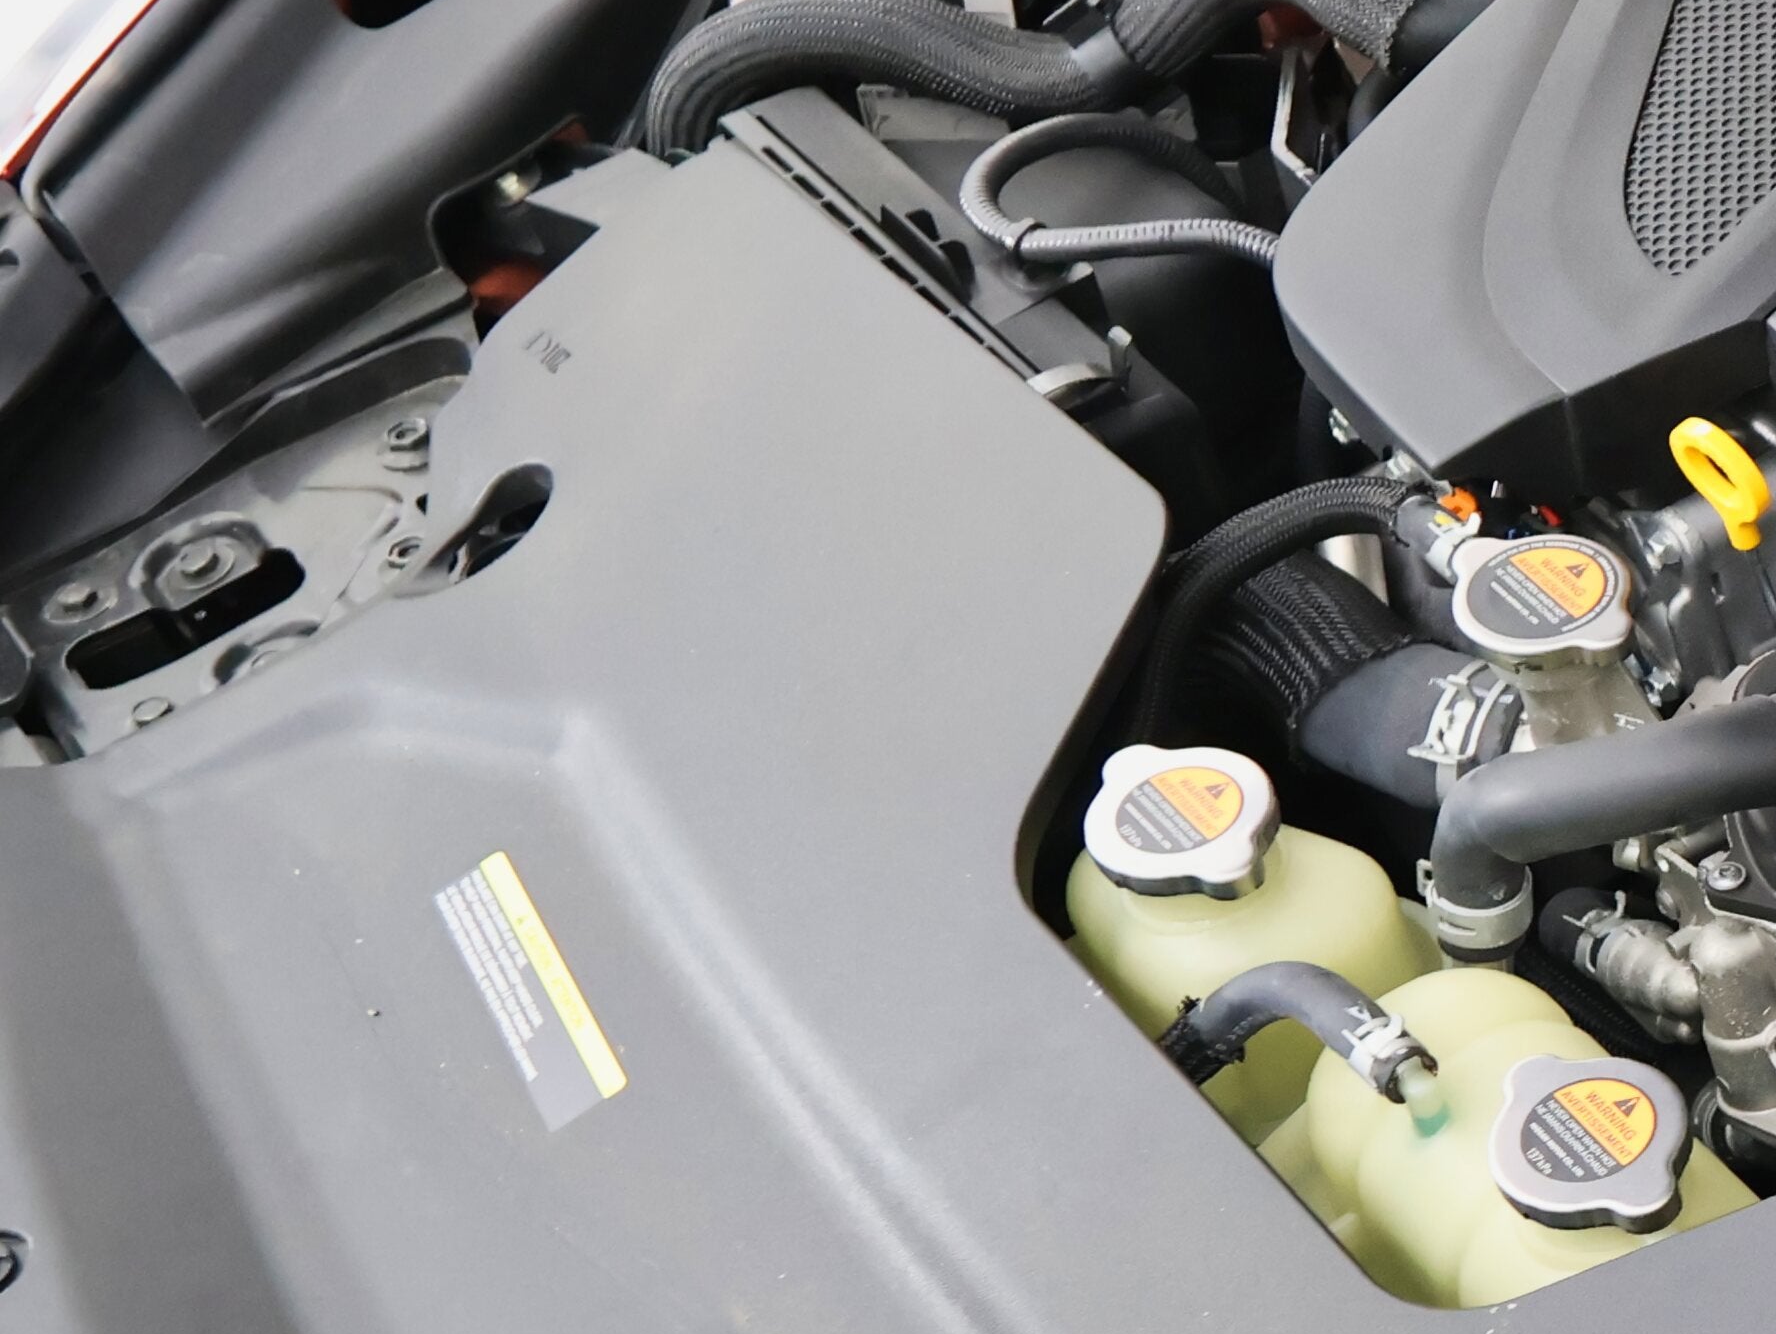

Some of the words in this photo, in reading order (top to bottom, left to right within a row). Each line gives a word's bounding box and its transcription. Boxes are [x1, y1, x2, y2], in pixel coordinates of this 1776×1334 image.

[1541, 557, 1585, 597] WARNING
[1562, 1091, 1632, 1158] AVERTISSEMENT
[1586, 1091, 1636, 1140] WARNING
